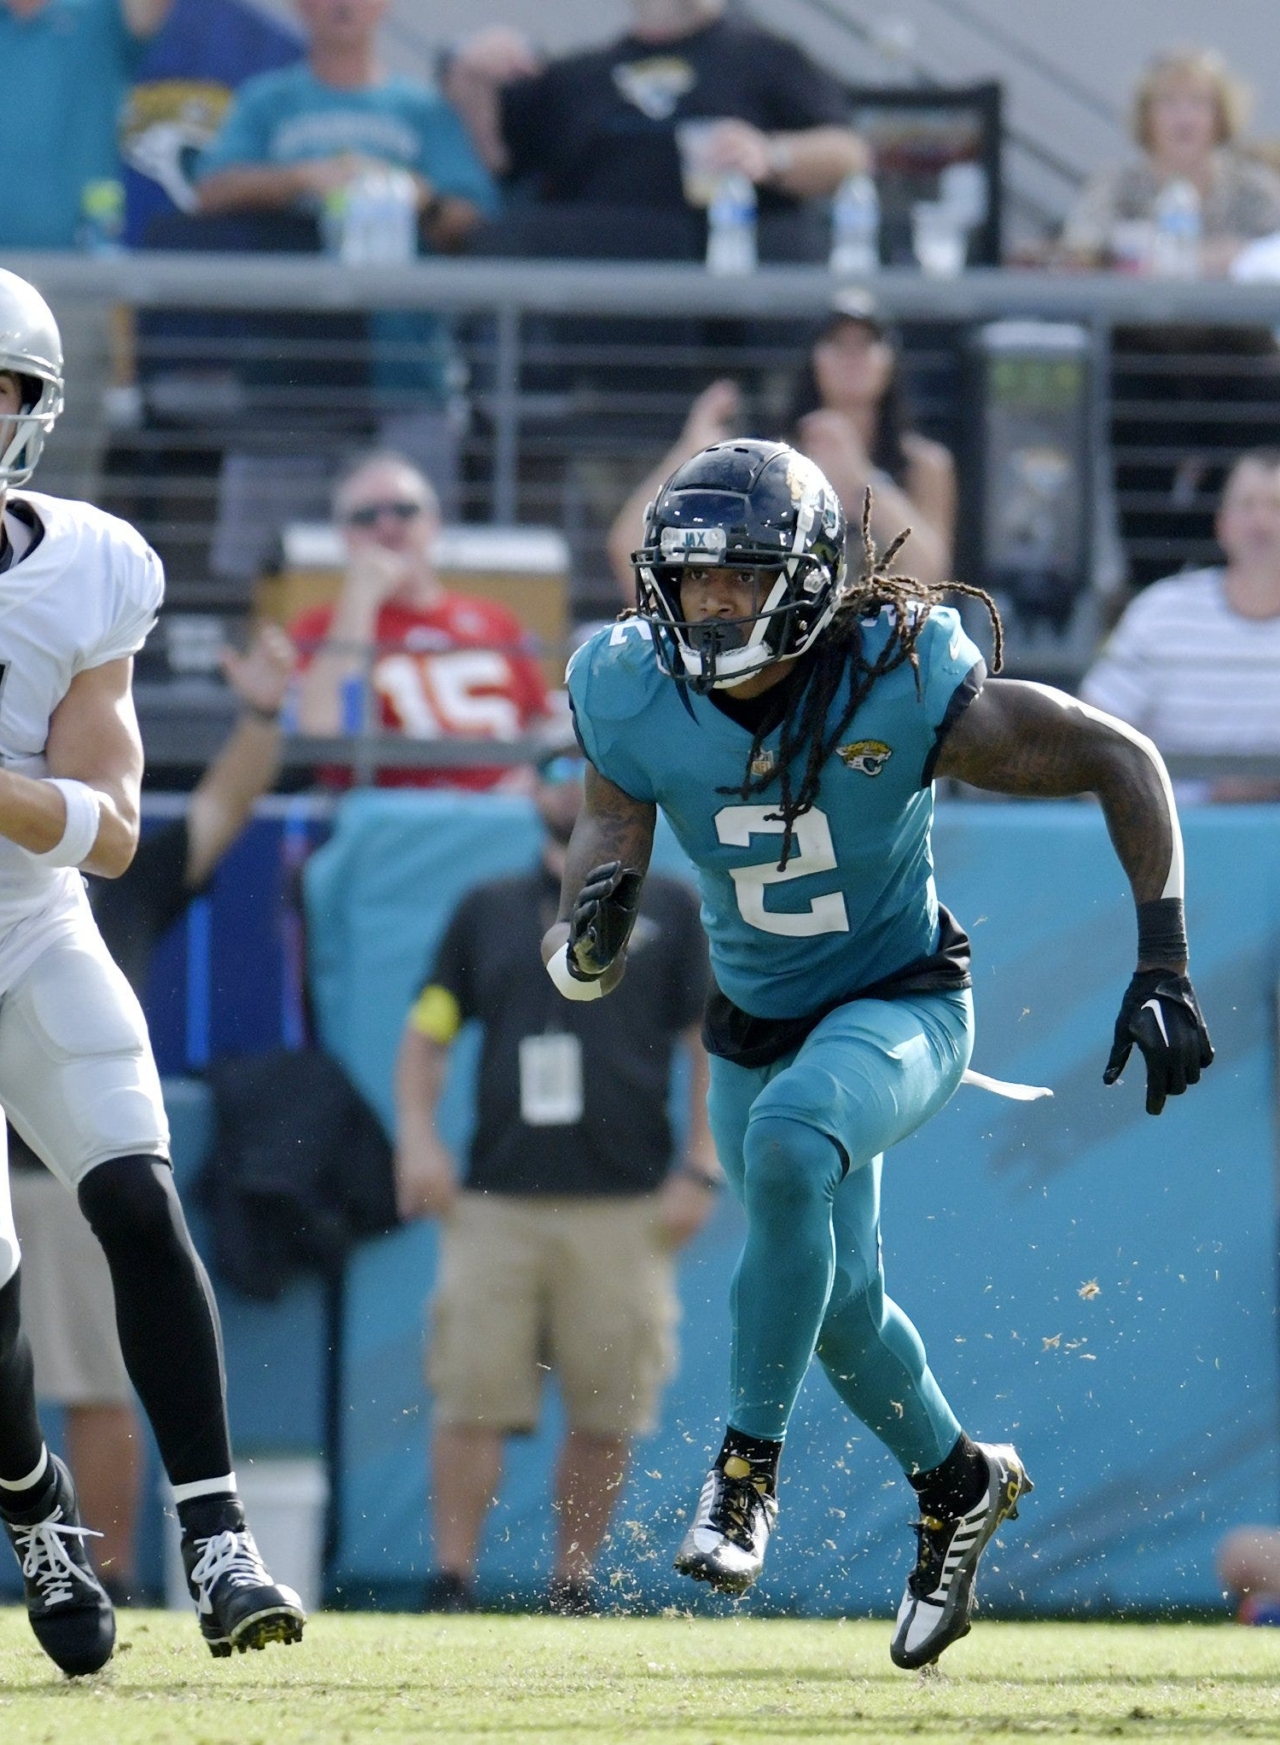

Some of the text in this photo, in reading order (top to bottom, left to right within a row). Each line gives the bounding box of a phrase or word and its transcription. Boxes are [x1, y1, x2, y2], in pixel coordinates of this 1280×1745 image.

[682, 532, 706, 547] JAX
[375, 648, 519, 741] 15
[713, 803, 850, 937] 2
